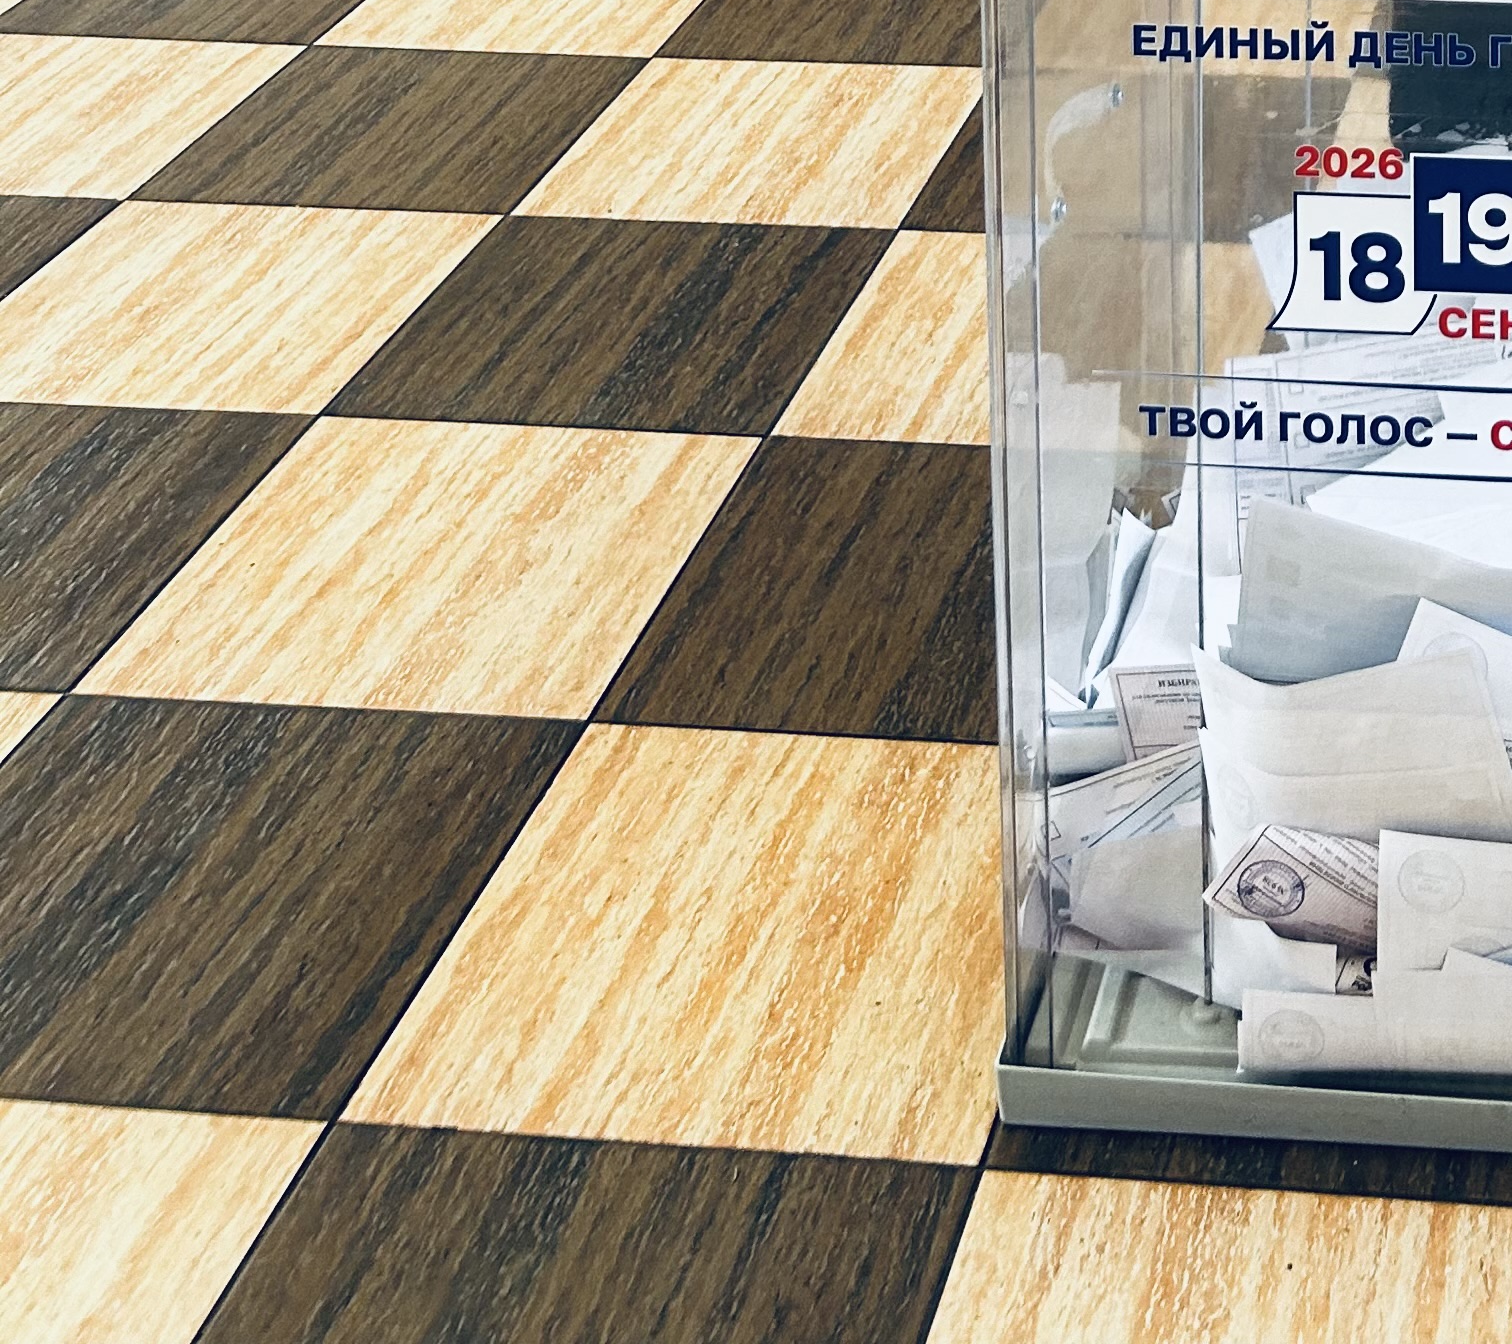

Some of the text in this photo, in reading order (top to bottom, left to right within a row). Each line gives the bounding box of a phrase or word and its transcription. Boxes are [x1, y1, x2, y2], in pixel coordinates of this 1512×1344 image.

[1132, 20, 1335, 63] ЕДИНЫЙ
[1348, 31, 1476, 69] ДЕНЬ
[1294, 145, 1405, 180] 2026
[1309, 230, 1406, 303] 18
[1138, 400, 1263, 441] ТВОЙ
[1279, 410, 1434, 447] ГОЛОС
